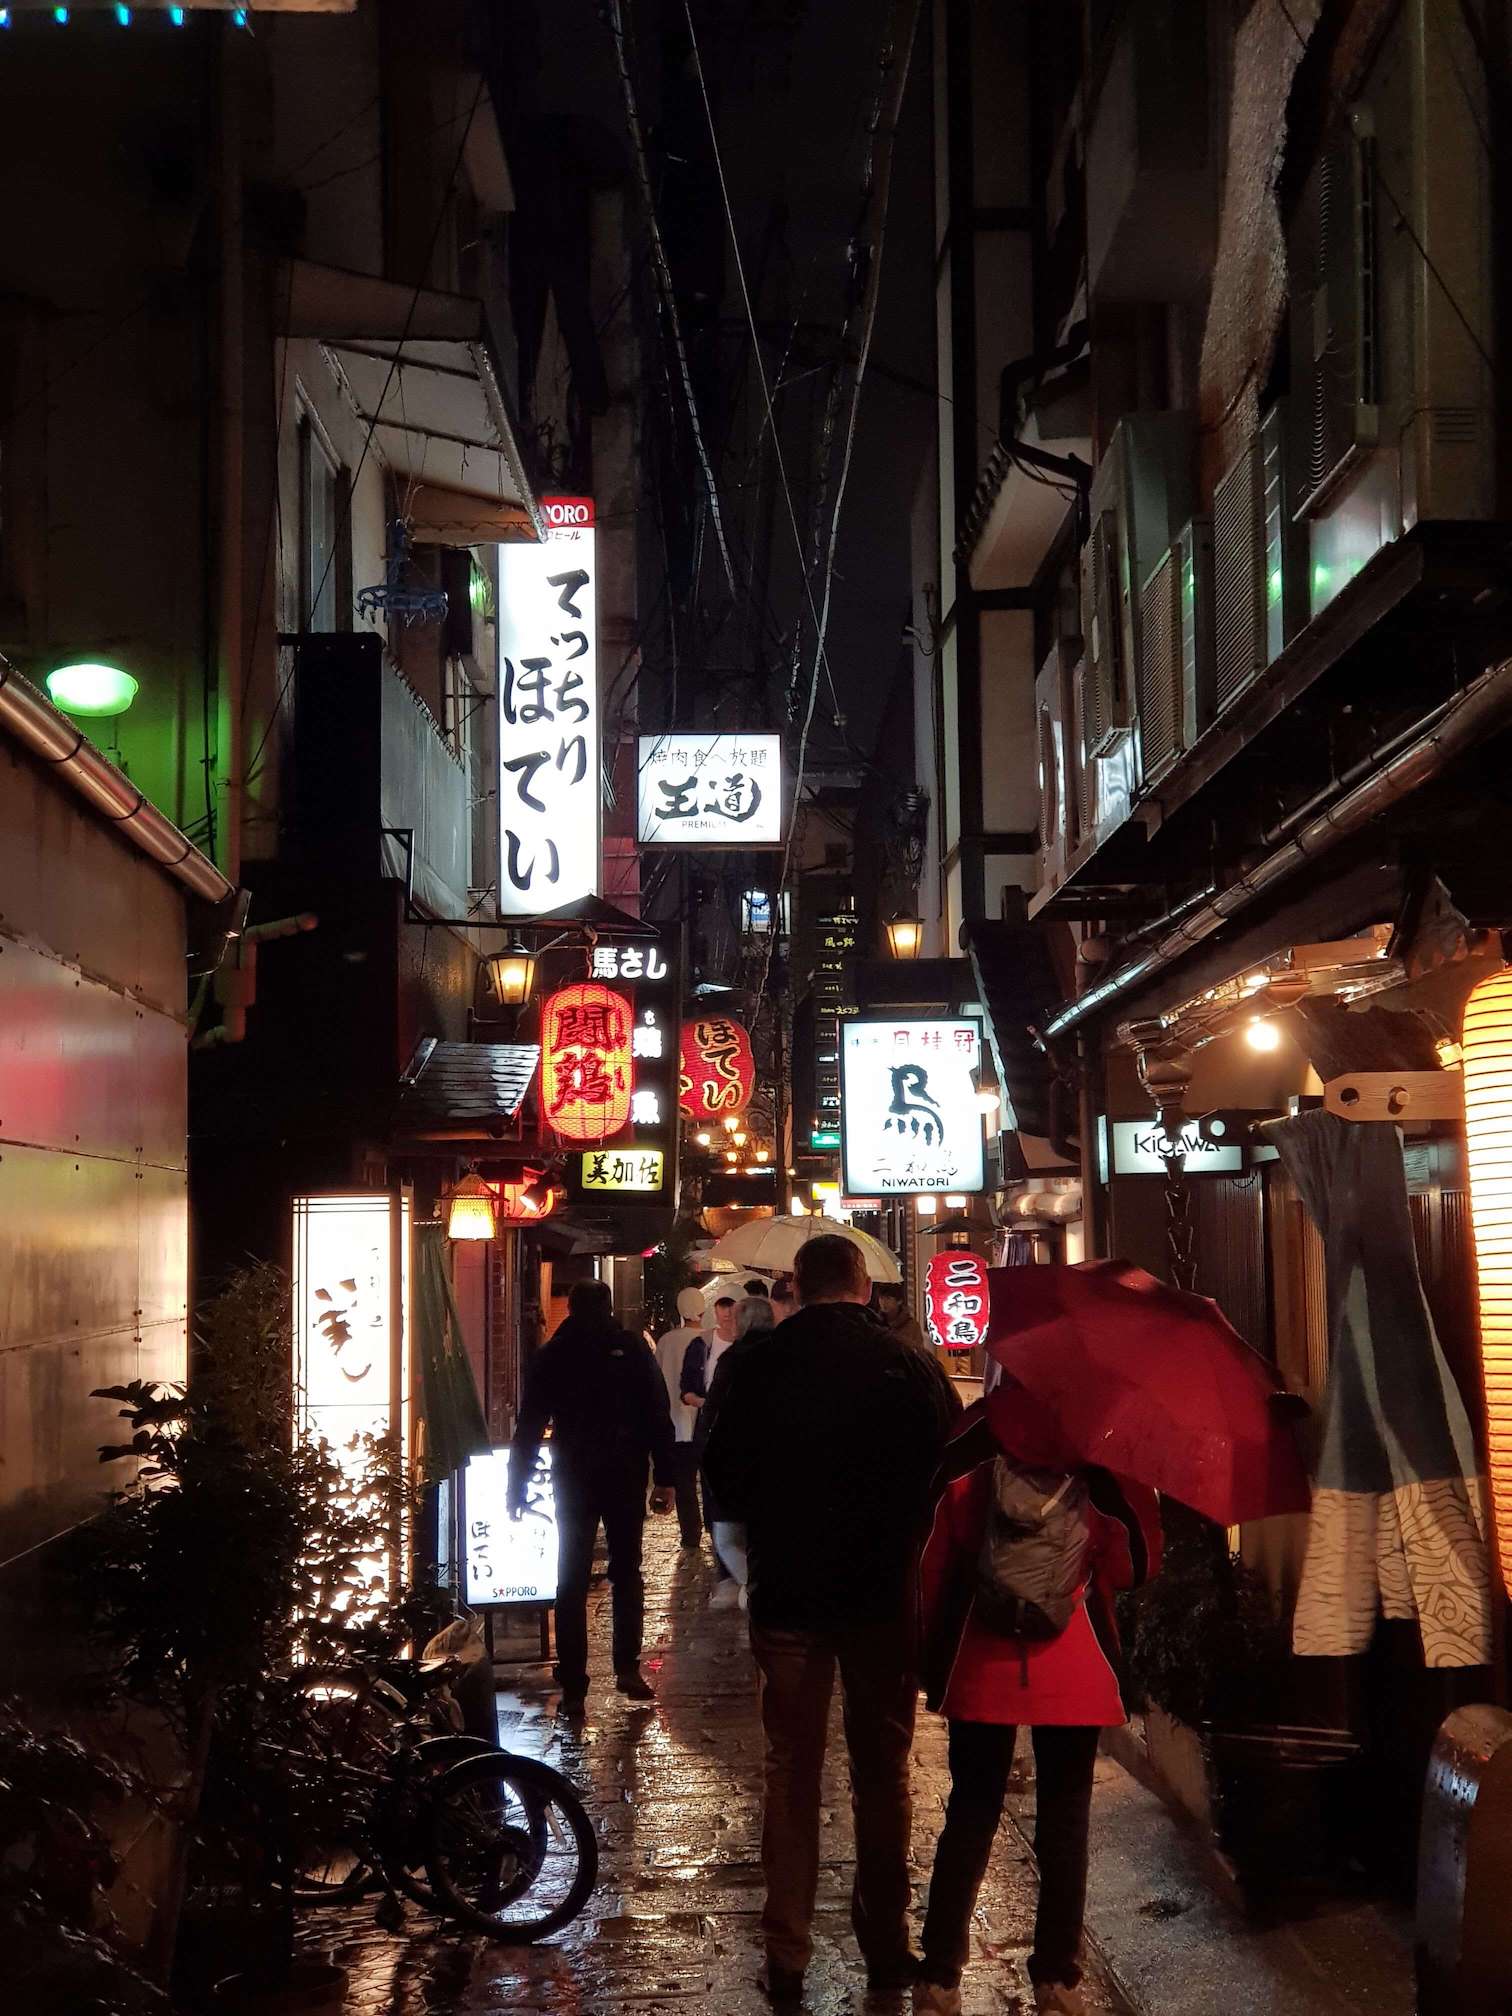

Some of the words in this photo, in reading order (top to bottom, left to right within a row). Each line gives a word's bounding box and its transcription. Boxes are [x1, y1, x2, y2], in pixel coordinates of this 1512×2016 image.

[546, 568, 590, 786] てっちり
[503, 656, 560, 891] ほてい
[655, 773, 762, 823] 王道
[592, 947, 667, 980] 馬さし
[696, 1020, 743, 1110] ほてい
[882, 1177, 950, 1188] NIWATORI
[945, 1262, 981, 1342] 二和鳥
